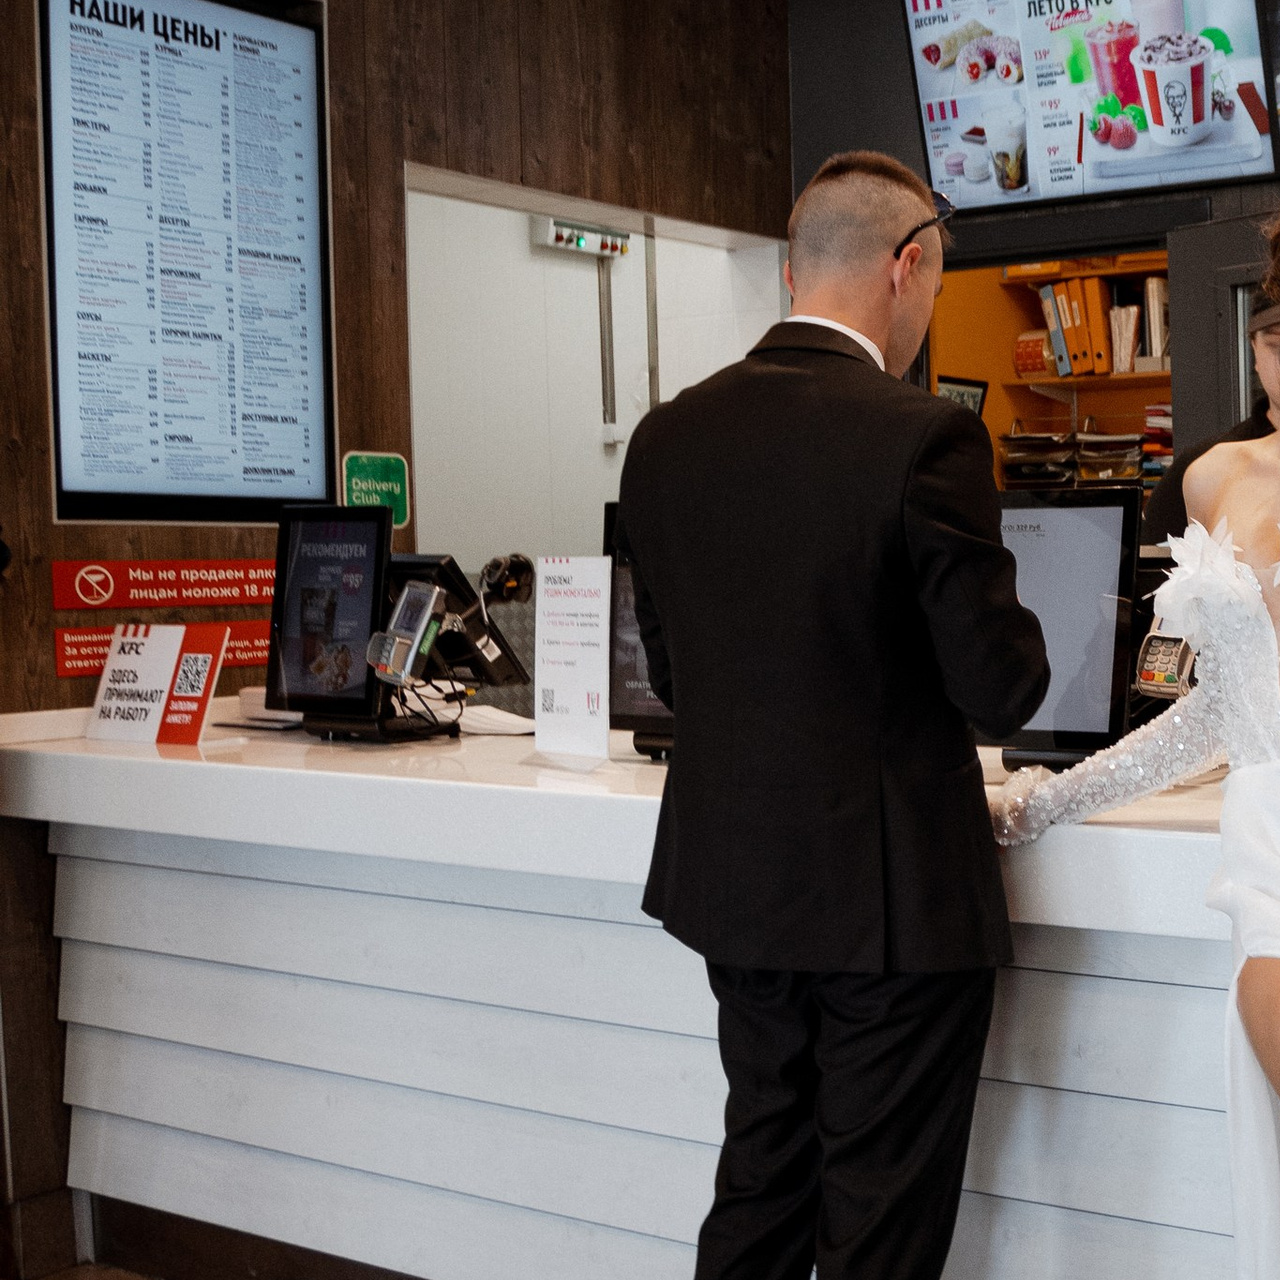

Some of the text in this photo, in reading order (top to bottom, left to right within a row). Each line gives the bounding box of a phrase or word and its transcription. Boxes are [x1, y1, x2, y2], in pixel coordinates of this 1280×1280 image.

[914, 13, 949, 30] ДЕСЕРТЫ
[351, 477, 401, 495] Delivery
[352, 491, 381, 505] Club
[301, 542, 367, 561] РЕКОМЕНДУЕМ
[128, 568, 153, 581] Мы
[158, 568, 176, 581] не
[180, 568, 245, 583] продаем
[129, 587, 178, 602] лицам
[182, 585, 240, 599] моложе
[243, 583, 259, 598] 18
[65, 647, 78, 656] За
[117, 641, 145, 656] KFC
[109, 668, 139, 685] ЗДЕСЬ
[103, 688, 164, 704] ПРИНИМАЮТ
[98, 705, 151, 721] НА РАБОТУ
